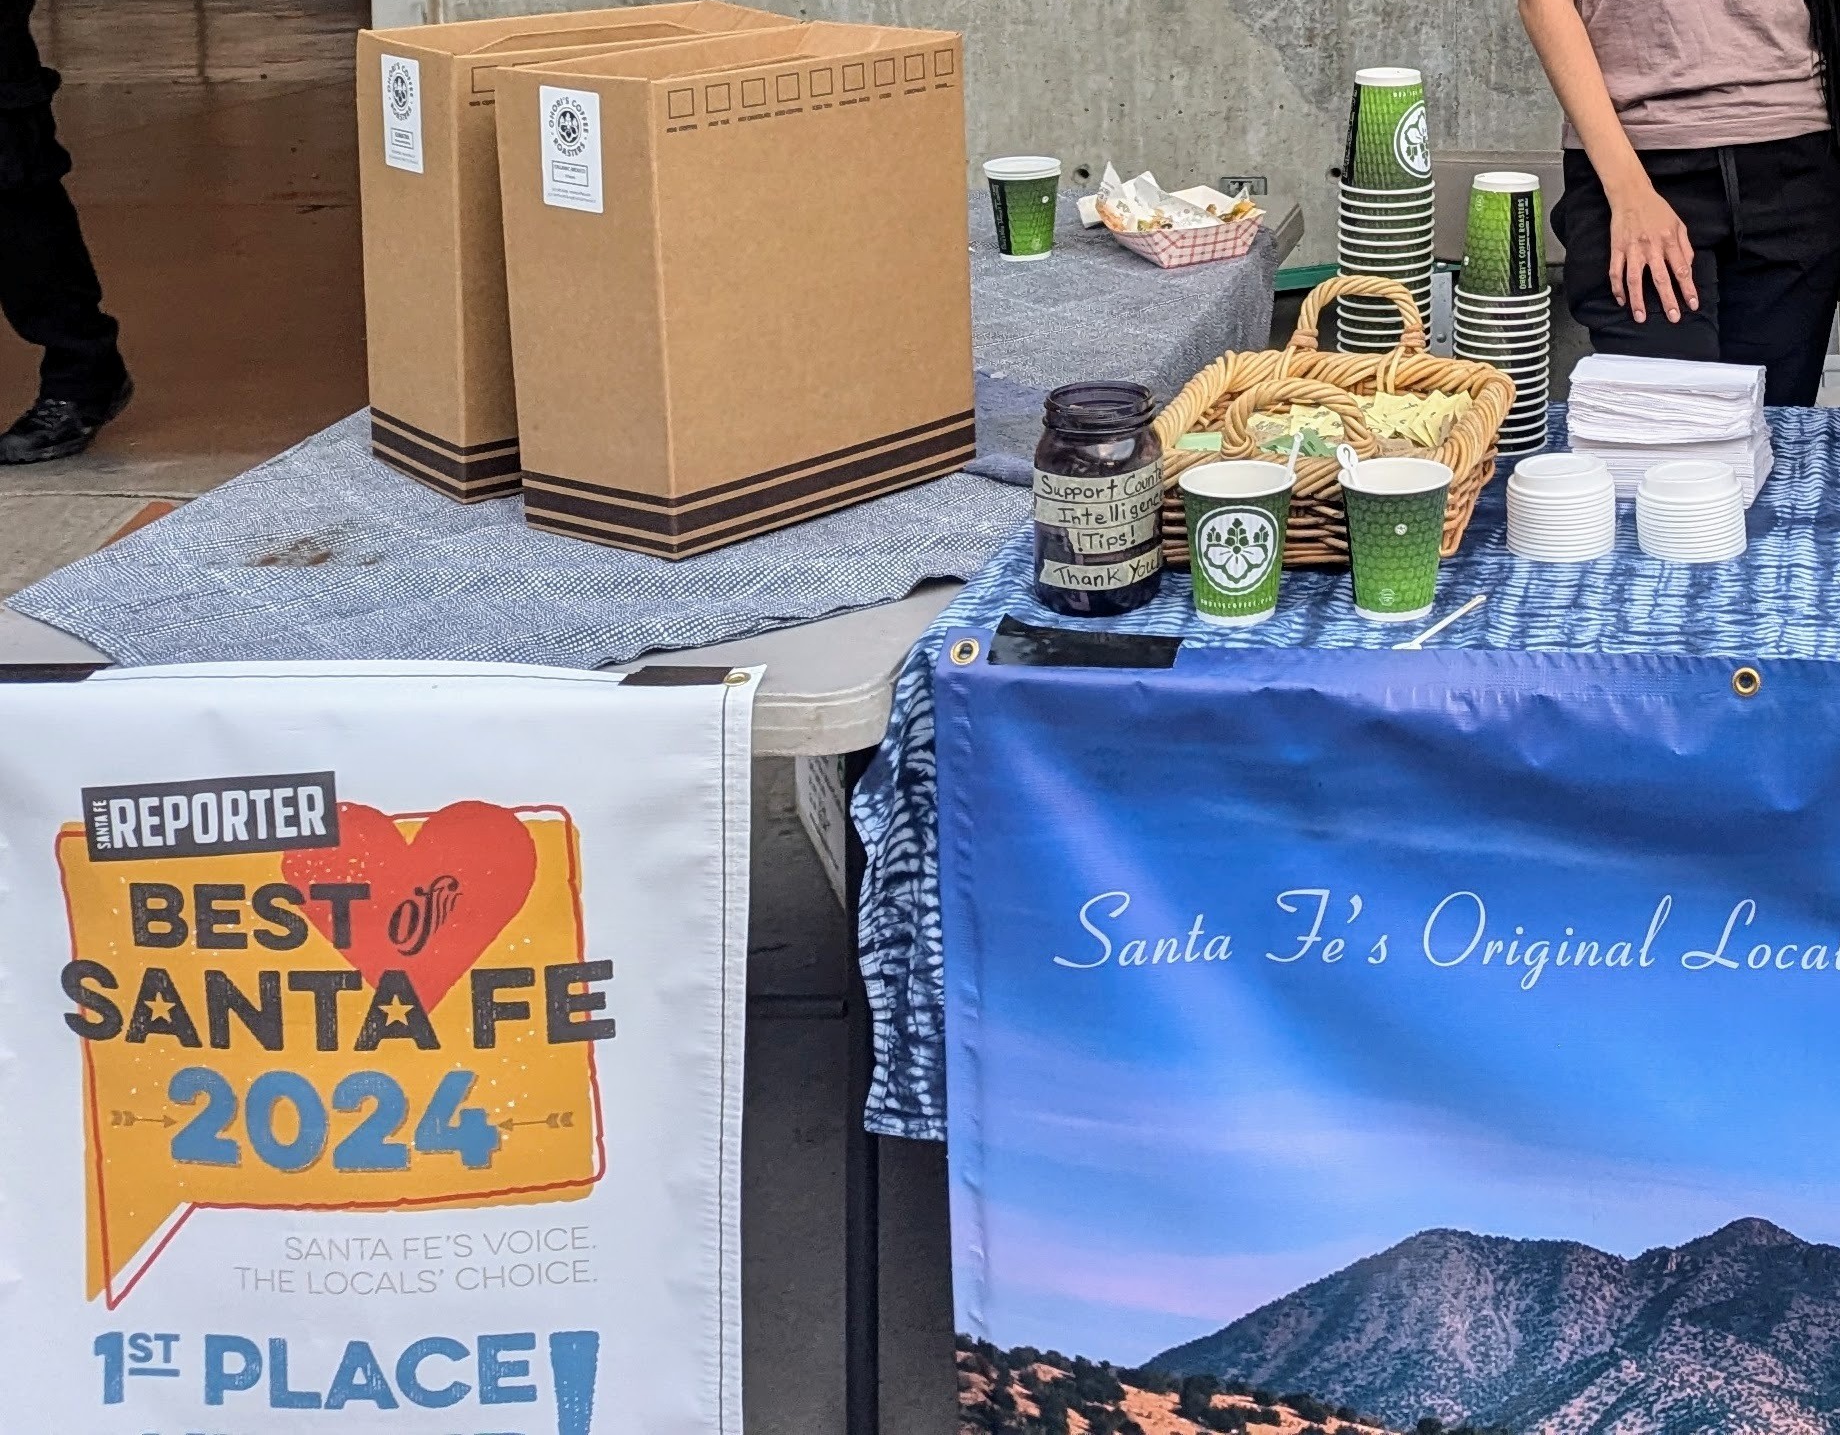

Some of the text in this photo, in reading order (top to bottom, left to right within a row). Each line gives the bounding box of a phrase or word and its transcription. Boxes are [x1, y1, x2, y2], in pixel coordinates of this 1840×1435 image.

[553, 137, 586, 157] ROASTERS
[1041, 475, 1118, 500] Support
[1053, 565, 1122, 587] Thank
[92, 799, 112, 850] SANTA FE
[109, 786, 326, 849] REPORTER
[129, 874, 461, 958] BEST of
[1054, 890, 1232, 970] Santa
[1263, 888, 1390, 965] Fe's
[1423, 891, 1672, 991] Original
[60, 958, 616, 1052] SANTA FE
[167, 1067, 500, 1173] 2024
[285, 1226, 597, 1261] SANTA FE'S VOICE.
[234, 1259, 597, 1296] THE LOCALS' CHOICE.
[93, 1331, 180, 1406] 1ST
